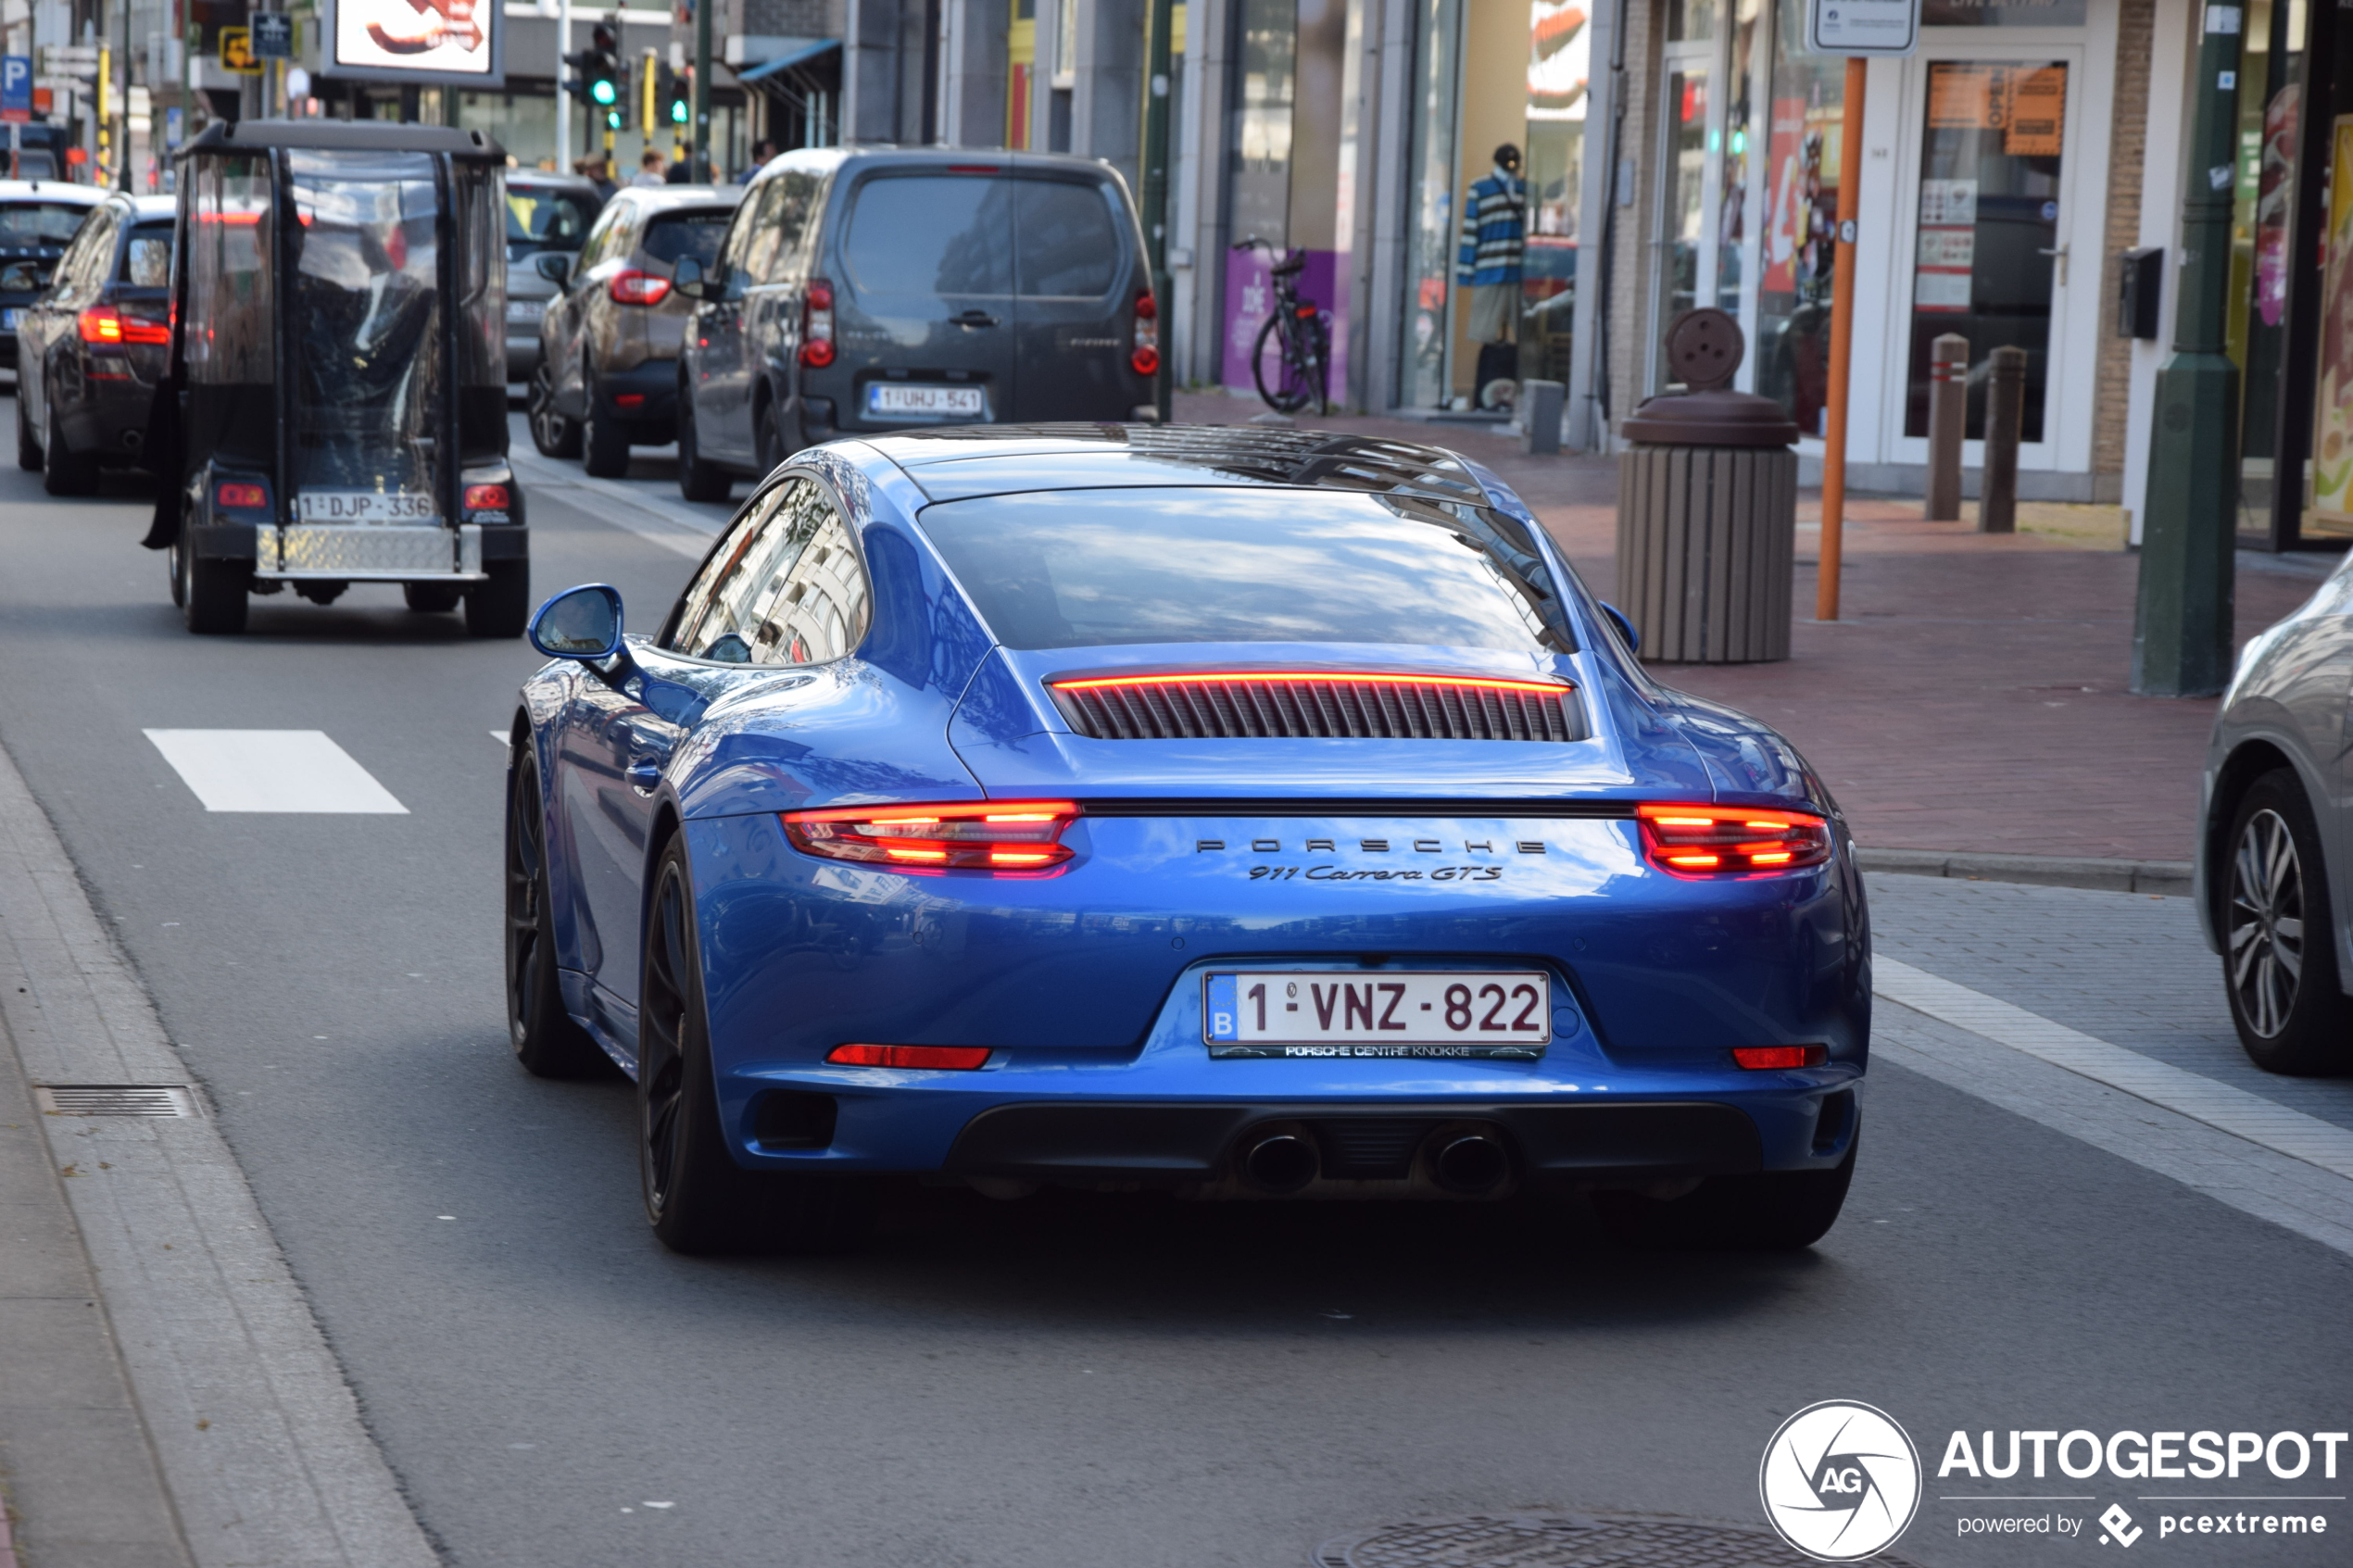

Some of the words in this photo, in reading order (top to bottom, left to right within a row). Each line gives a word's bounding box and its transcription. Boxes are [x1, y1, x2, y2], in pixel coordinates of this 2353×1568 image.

[6, 60, 27, 91] P
[1989, 69, 2005, 127] OPEN
[303, 496, 430, 517] 1-DJP-336
[1196, 839, 1546, 853] PORSCHE
[1249, 865, 1300, 881] 911
[1305, 865, 1423, 881] Carrera
[1430, 866, 1503, 881] GTS
[1214, 1012, 1233, 1035] B
[1248, 983, 1541, 1031] 1-VNZ-822
[1286, 1046, 1351, 1057] PORSCHE
[1354, 1046, 1409, 1057] CENTRE
[1413, 1046, 1470, 1057] KNOKKE
